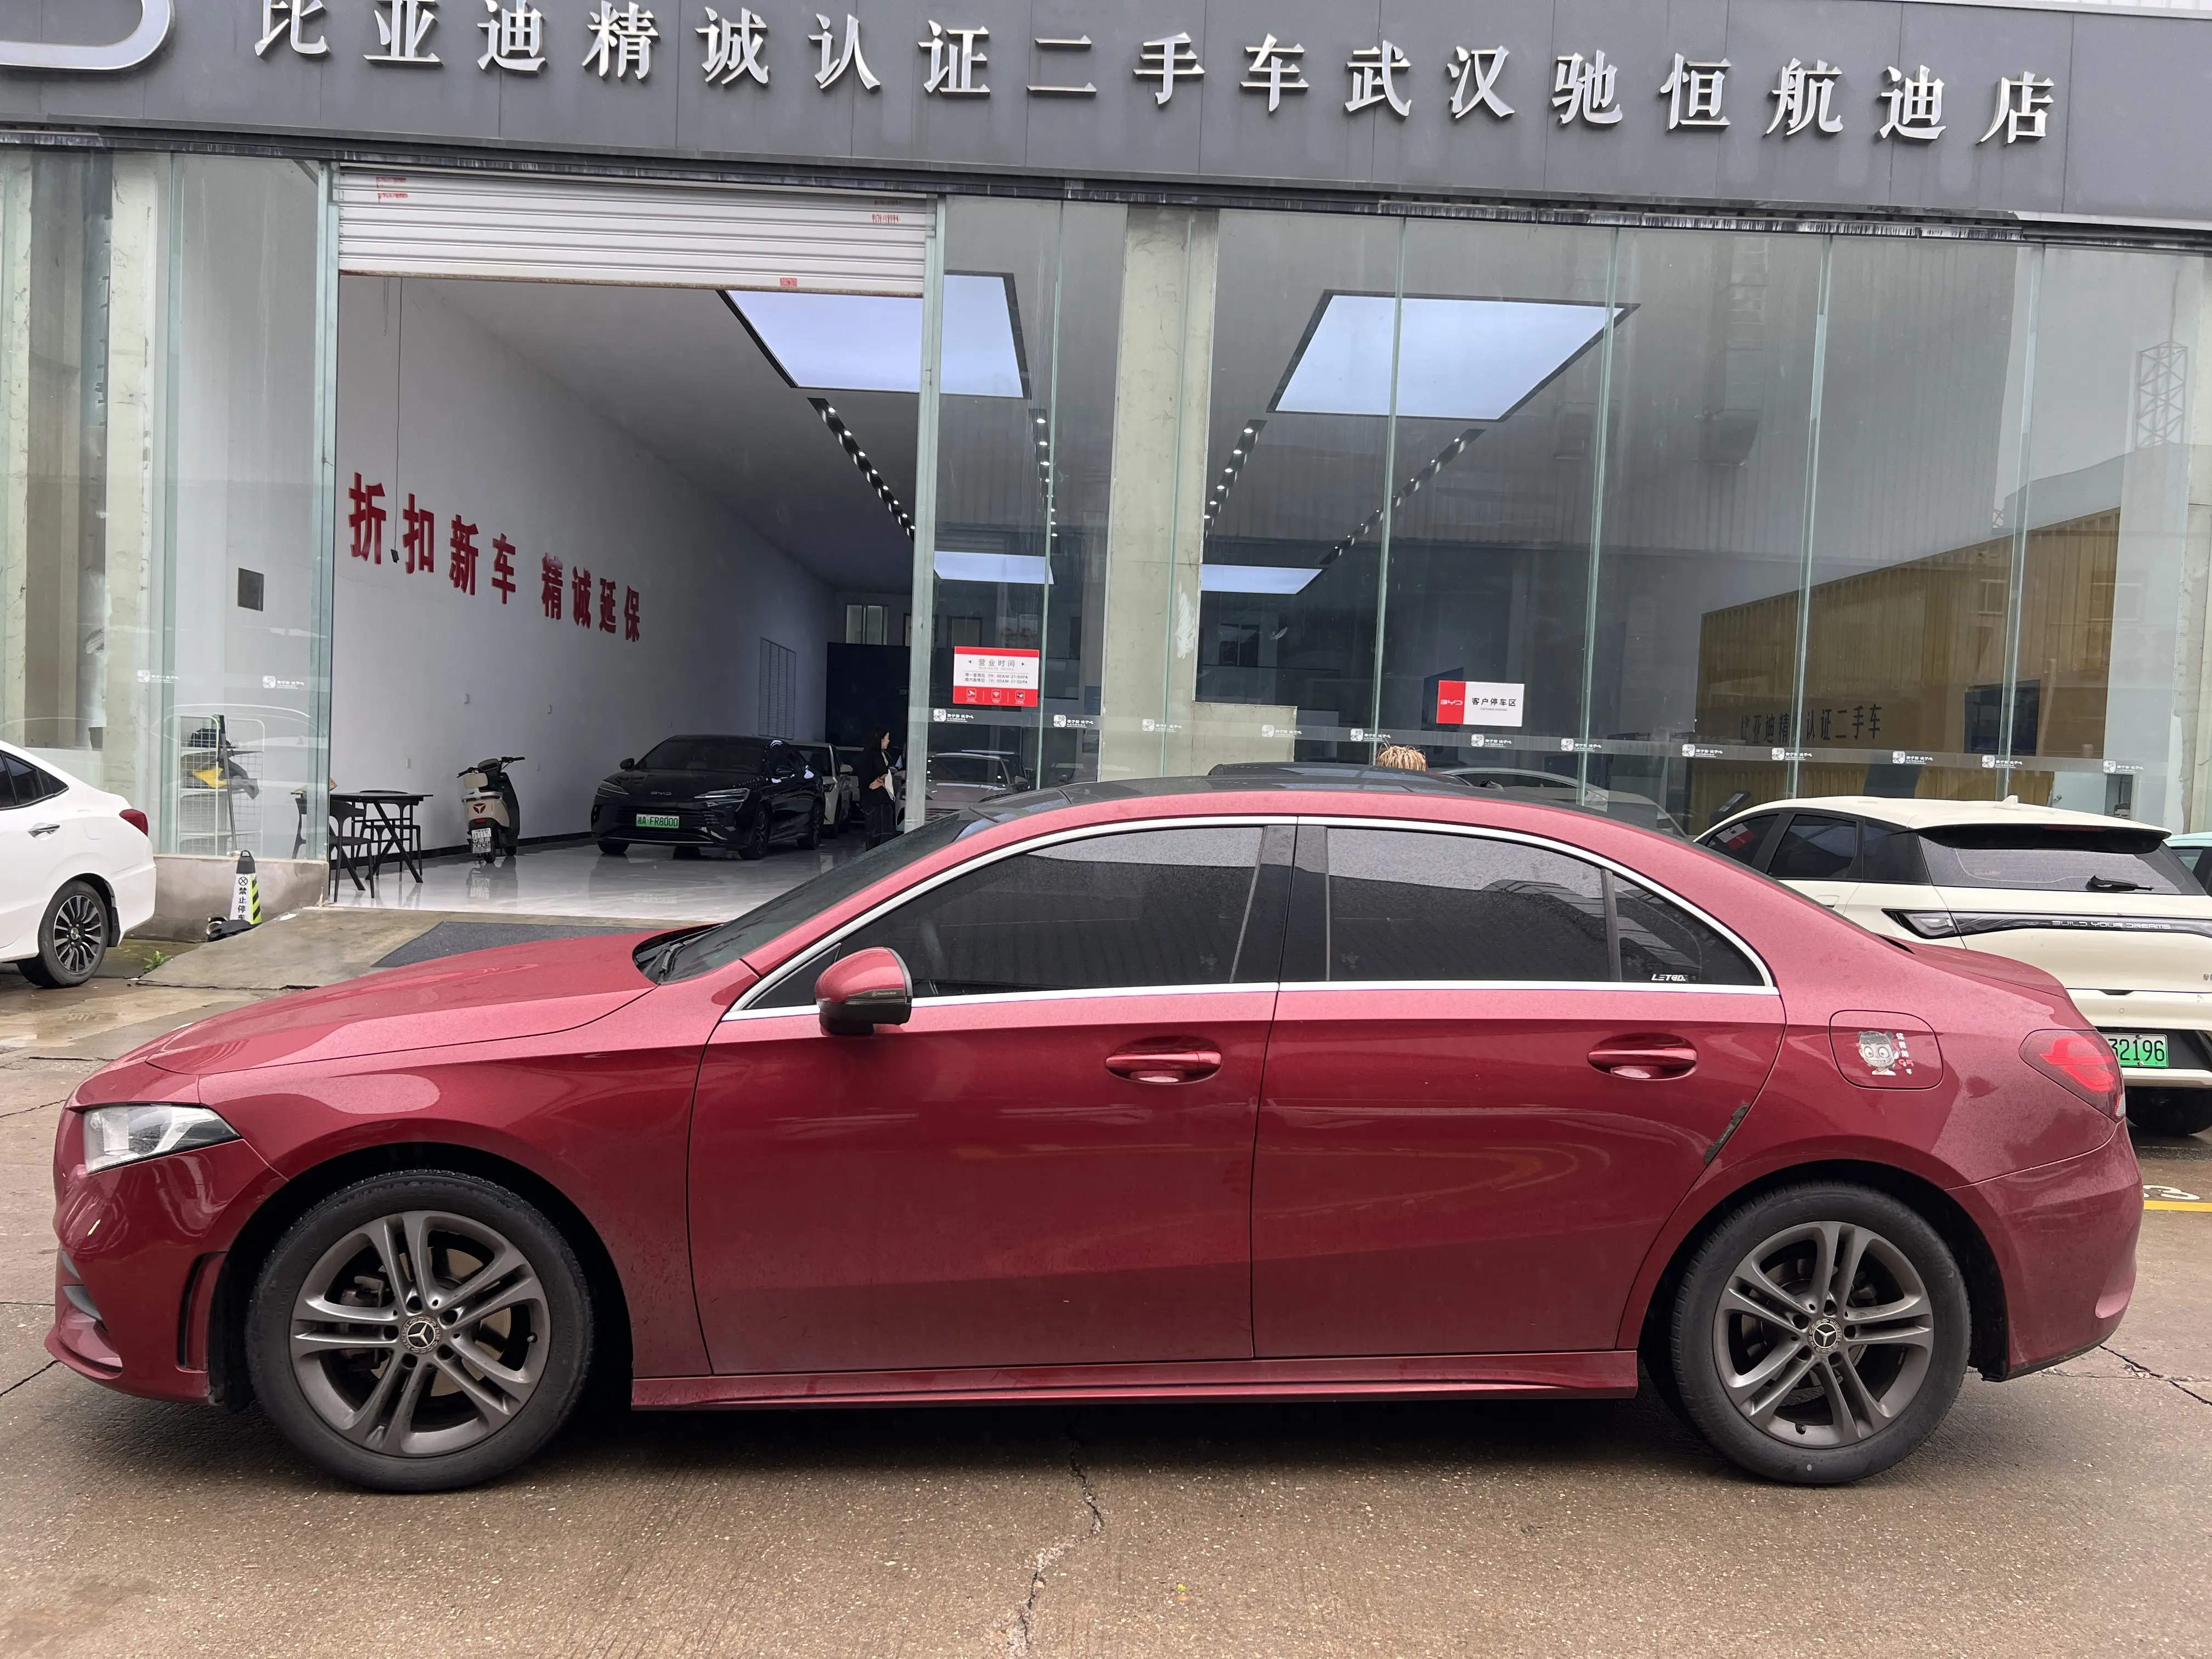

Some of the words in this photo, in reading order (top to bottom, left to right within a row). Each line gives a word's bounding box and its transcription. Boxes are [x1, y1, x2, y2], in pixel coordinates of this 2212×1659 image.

[348, 472, 516, 605] 折扣新车
[540, 552, 641, 642] 精诚延保
[978, 658, 1015, 668] 营业时间
[1471, 697, 1516, 707] 客户停车区
[1741, 704, 1882, 744] 比亚迪精认证二手车
